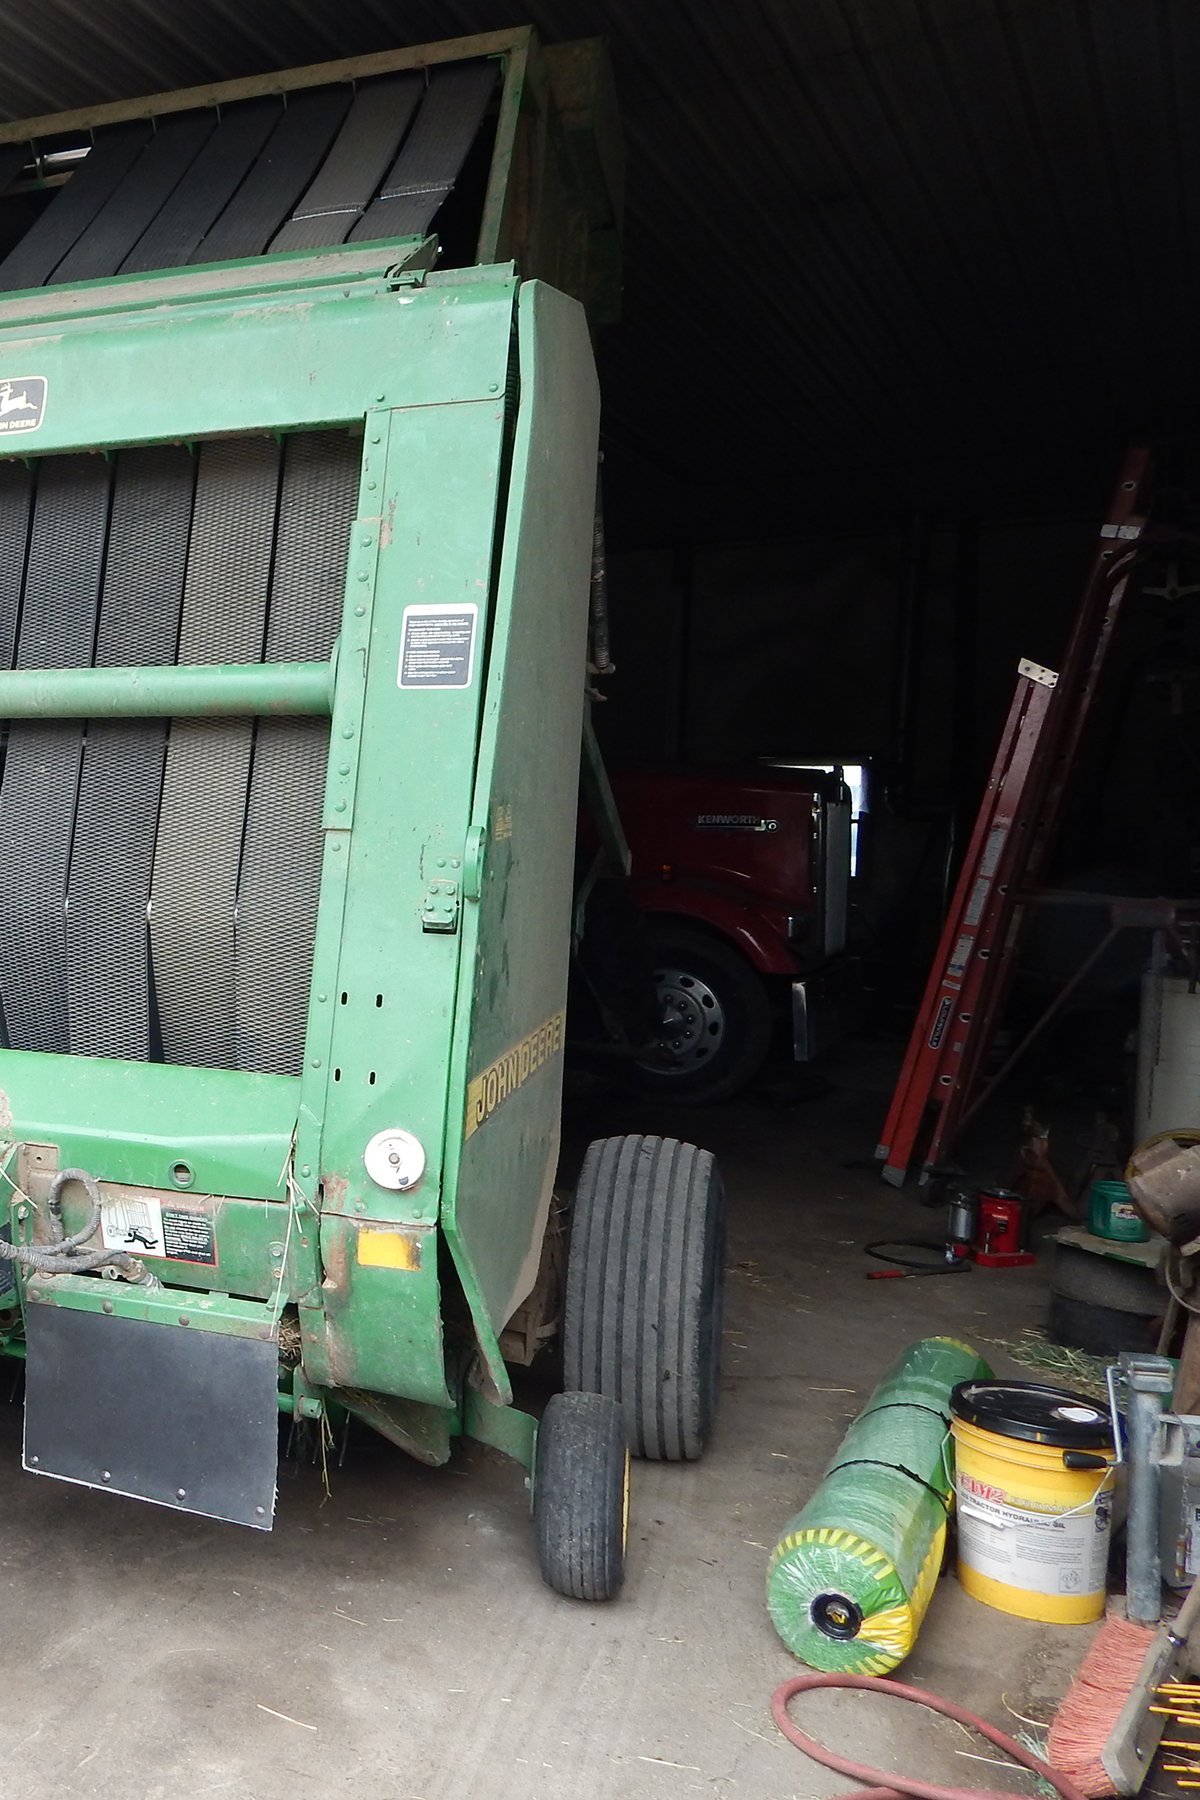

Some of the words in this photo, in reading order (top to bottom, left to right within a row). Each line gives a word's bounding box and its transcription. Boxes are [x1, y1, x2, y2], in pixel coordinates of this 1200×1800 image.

[10, 418, 36, 429] DEERE
[697, 815, 761, 825] KENWORTH
[476, 1051, 519, 1123] JOHN
[521, 1016, 561, 1080] DEERE
[969, 1496, 1001, 1515] TRACTOR
[1002, 1511, 1049, 1527] HYDRAC
